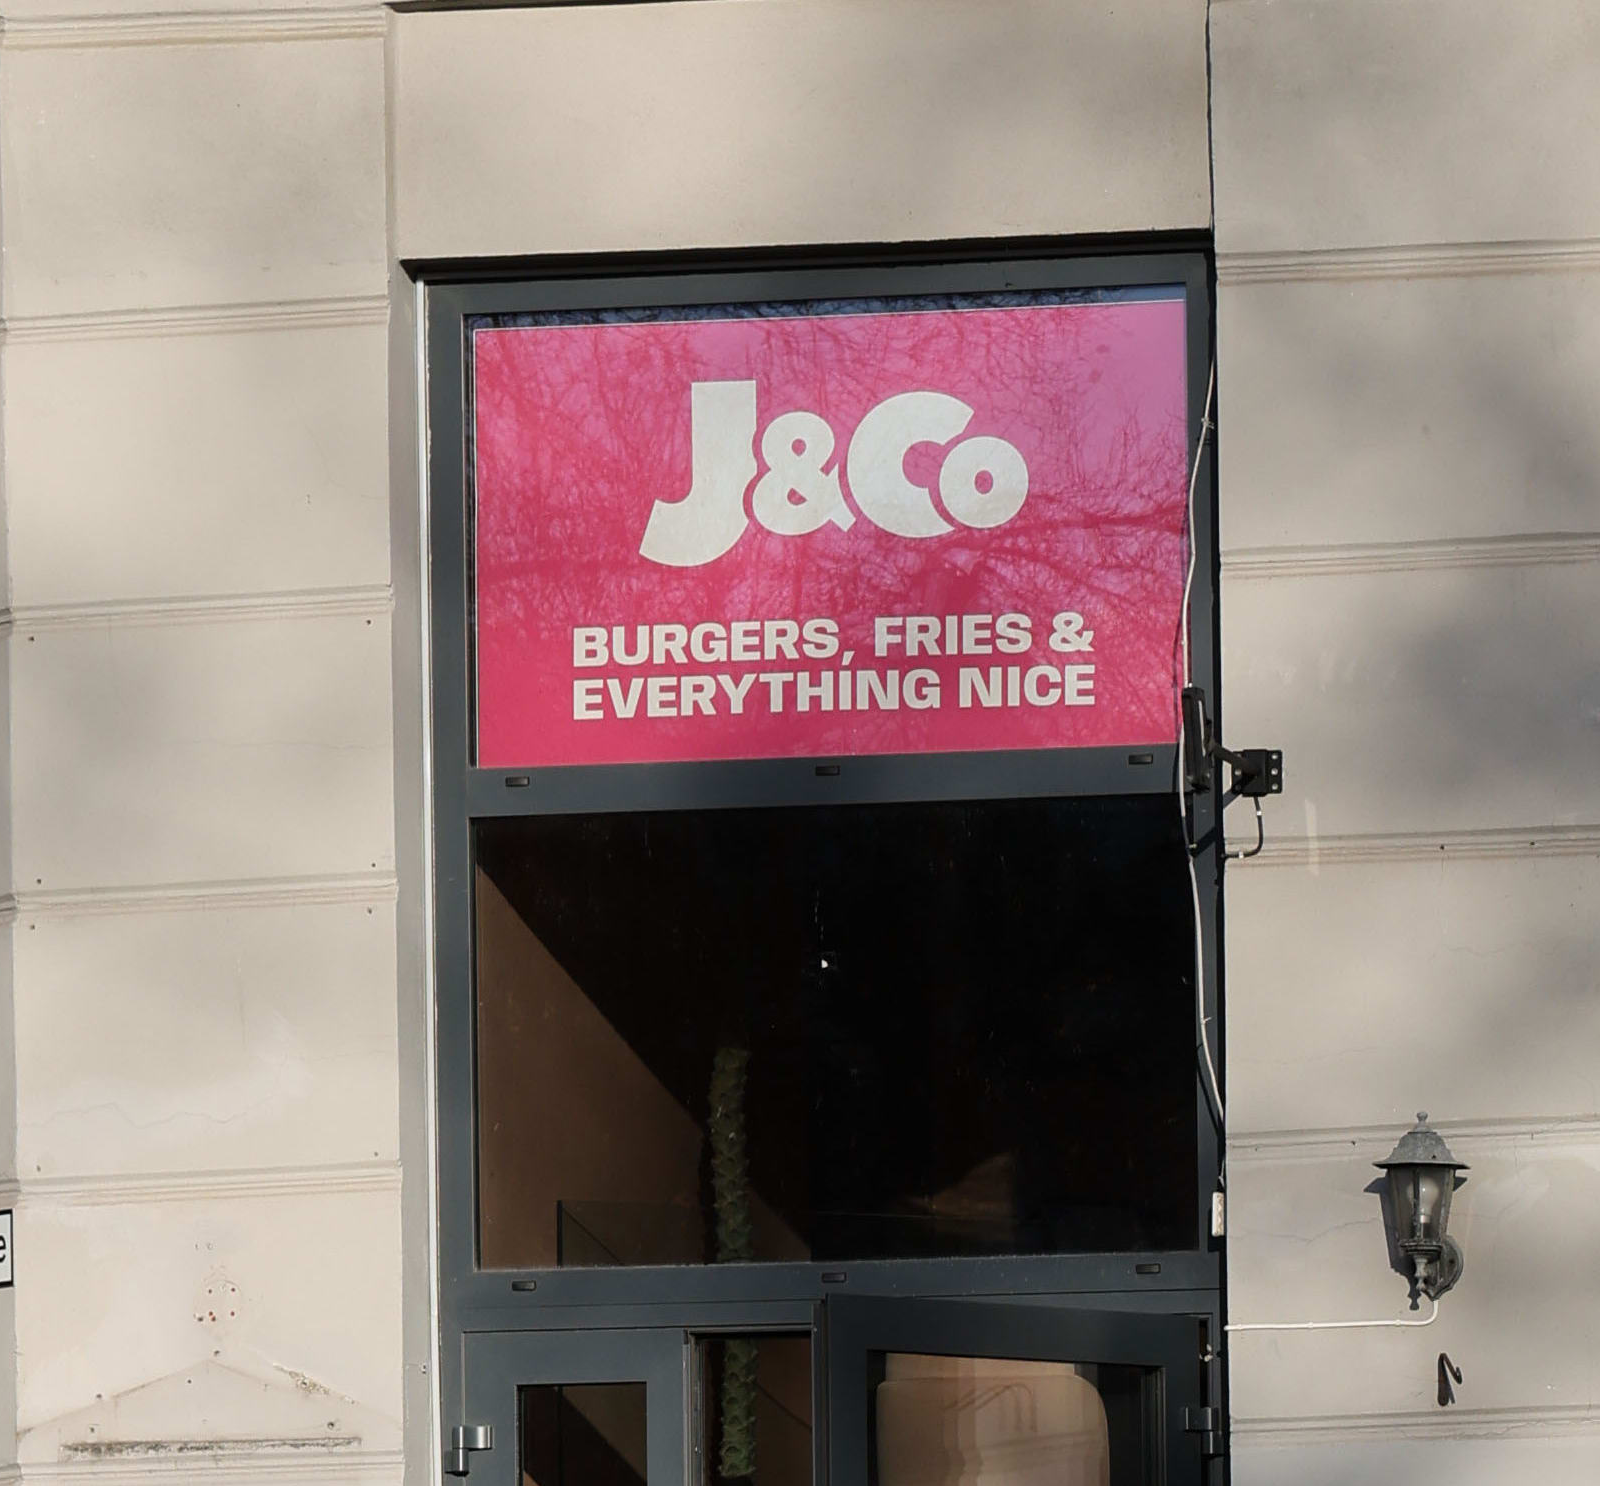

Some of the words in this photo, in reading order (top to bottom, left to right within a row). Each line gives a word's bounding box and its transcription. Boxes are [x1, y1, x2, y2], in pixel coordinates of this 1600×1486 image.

[639, 380, 1029, 567] J&Co
[572, 618, 855, 666] BURGERS,
[874, 614, 1032, 656] FRIES
[1048, 612, 1095, 653] &
[572, 667, 941, 721] EVERYTHING
[959, 664, 1096, 709] NICE
